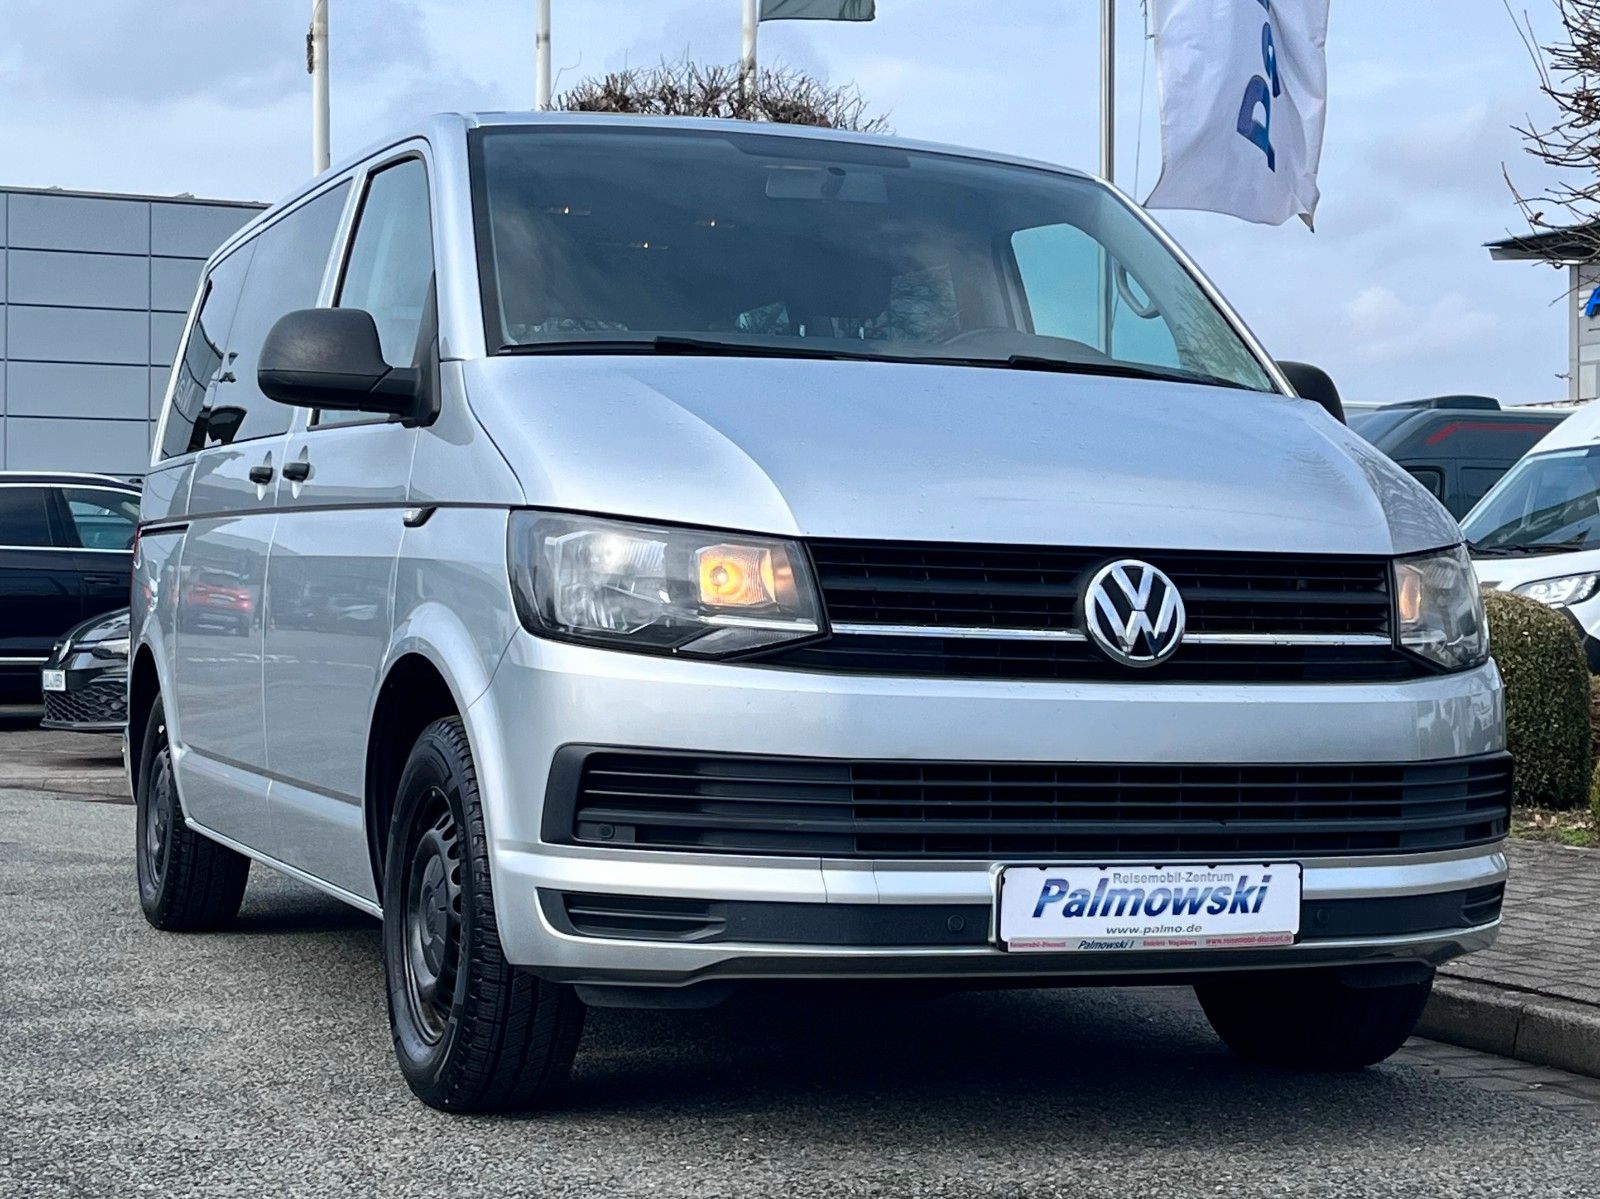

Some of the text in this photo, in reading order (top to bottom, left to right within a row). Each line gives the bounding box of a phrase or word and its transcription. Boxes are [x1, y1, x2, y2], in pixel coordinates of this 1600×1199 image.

[1113, 872, 1235, 884] Reisemobil-Zentrum
[1033, 875, 1272, 918] Palmowski
[1106, 924, 1202, 936] www.palmo.de
[1078, 939, 1129, 949] Palmowski
